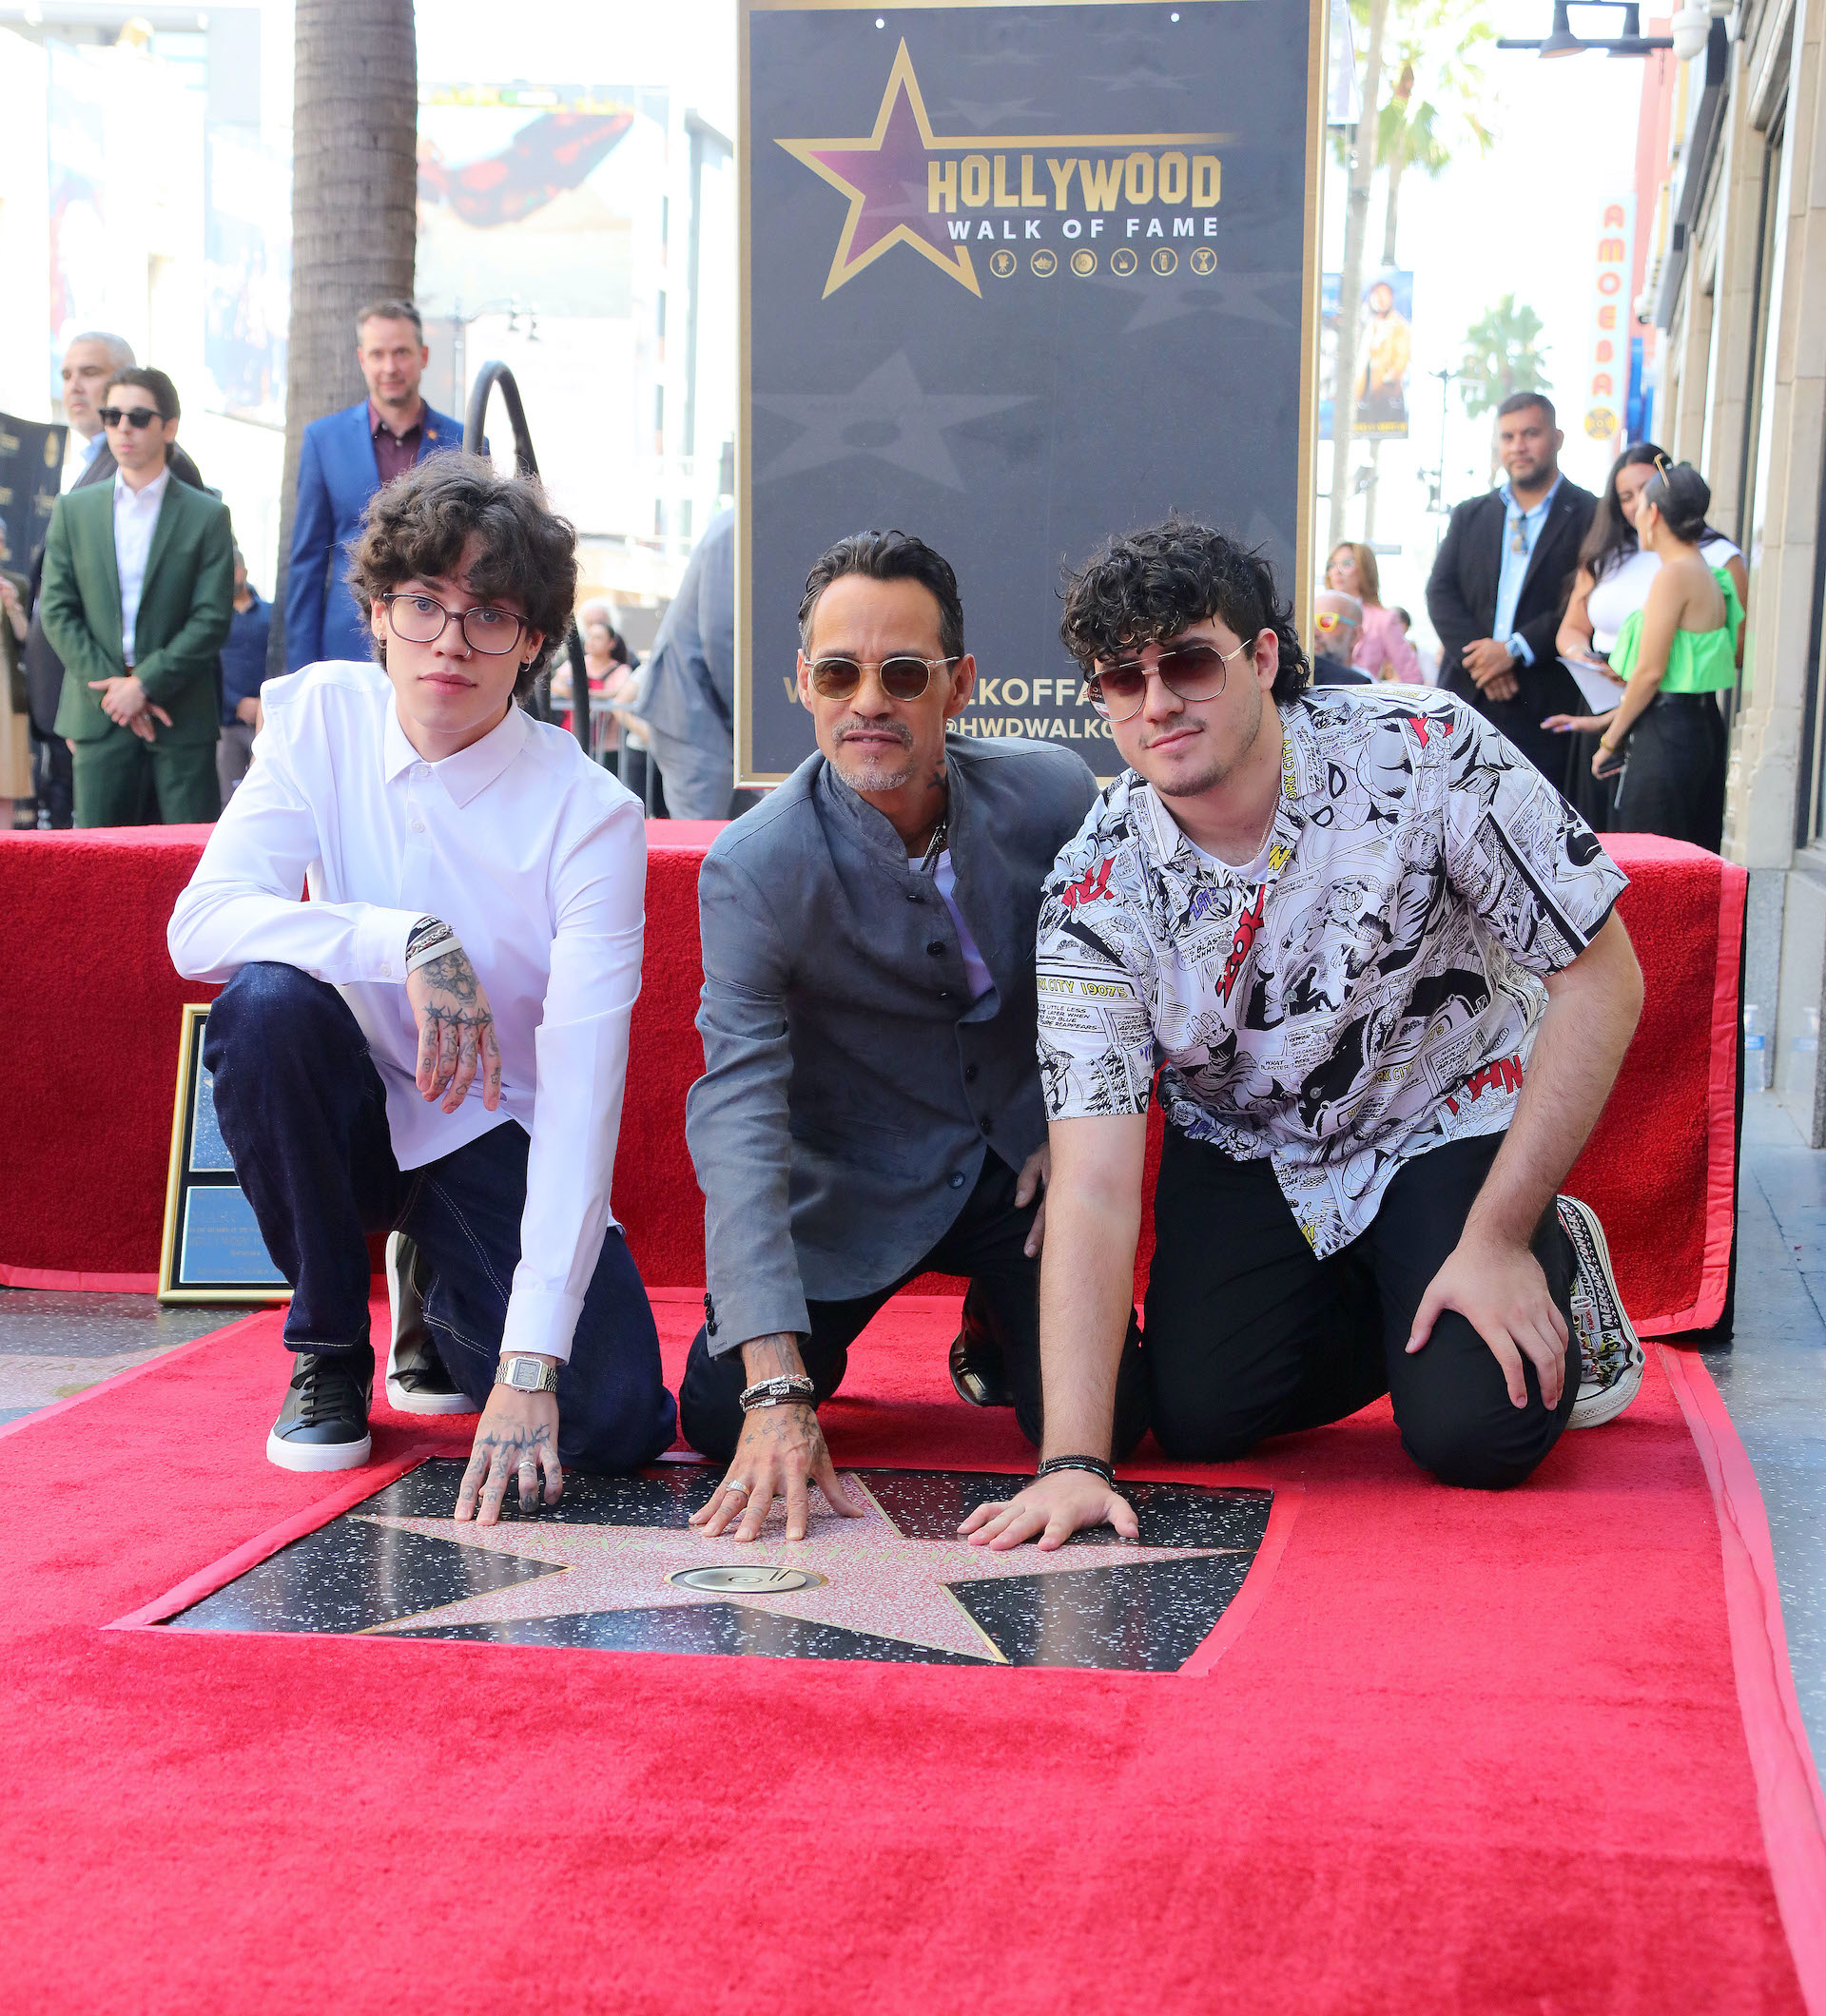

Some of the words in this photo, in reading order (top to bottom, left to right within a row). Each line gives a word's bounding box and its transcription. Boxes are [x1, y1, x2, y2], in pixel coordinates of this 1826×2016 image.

[927, 152, 1221, 213] HOLLYWOOD
[948, 220, 1041, 241] WALK
[1062, 218, 1104, 239] OF
[1126, 217, 1218, 238] FAME
[1591, 203, 1625, 397] AMOEBA
[1048, 979, 1075, 994] CITY
[526, 1534, 694, 1554] MARC
[736, 1542, 1024, 1566] ANTHONY
